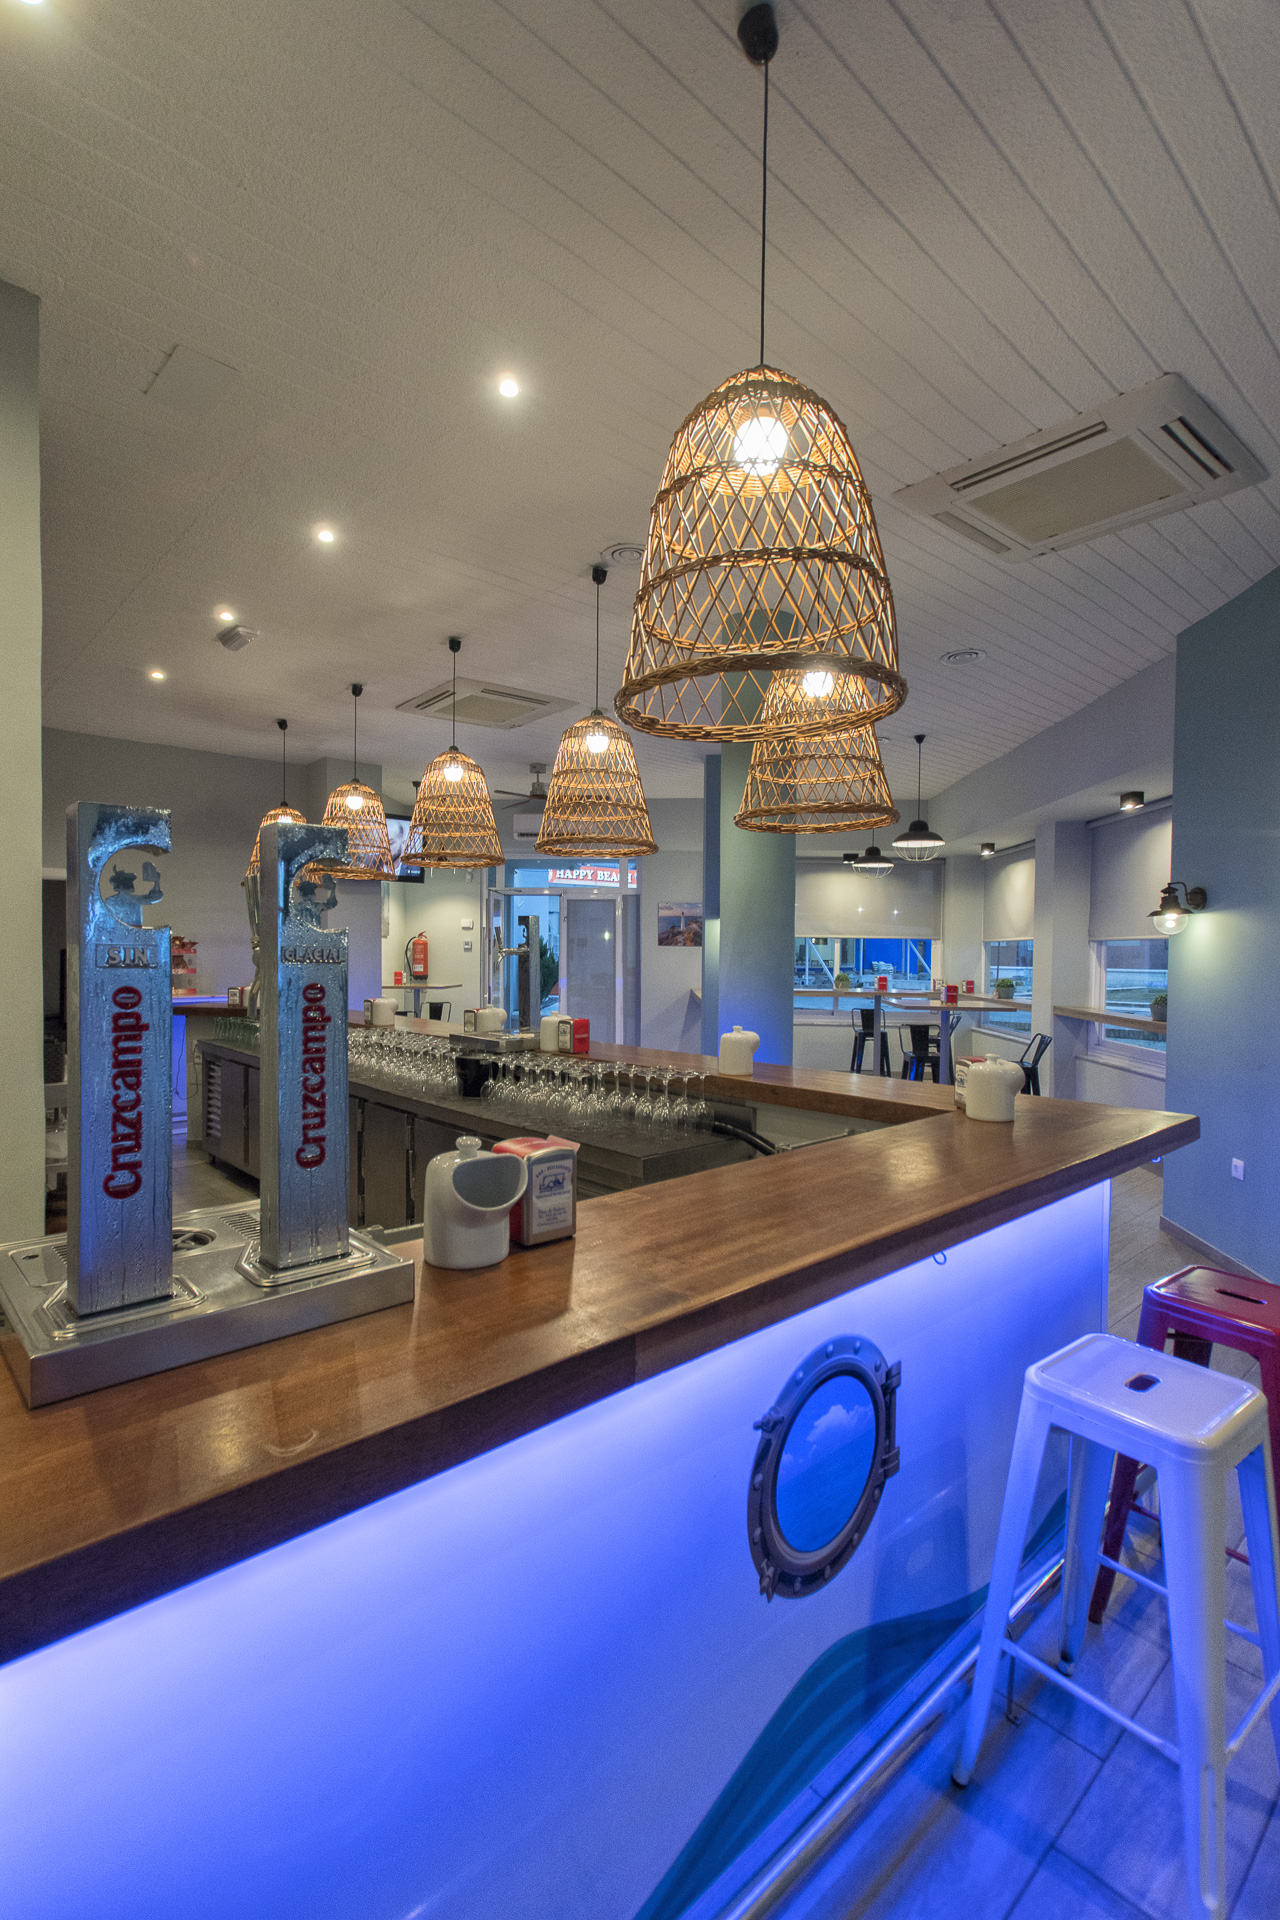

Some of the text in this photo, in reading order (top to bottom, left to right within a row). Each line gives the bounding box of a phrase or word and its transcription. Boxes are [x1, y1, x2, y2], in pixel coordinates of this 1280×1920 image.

[556, 869, 595, 880] HAPPY
[107, 946, 149, 966] SIN
[286, 946, 346, 962] GLACIAL
[296, 983, 331, 1169] Cruzcampo
[103, 985, 149, 1199] Cruzcampo
